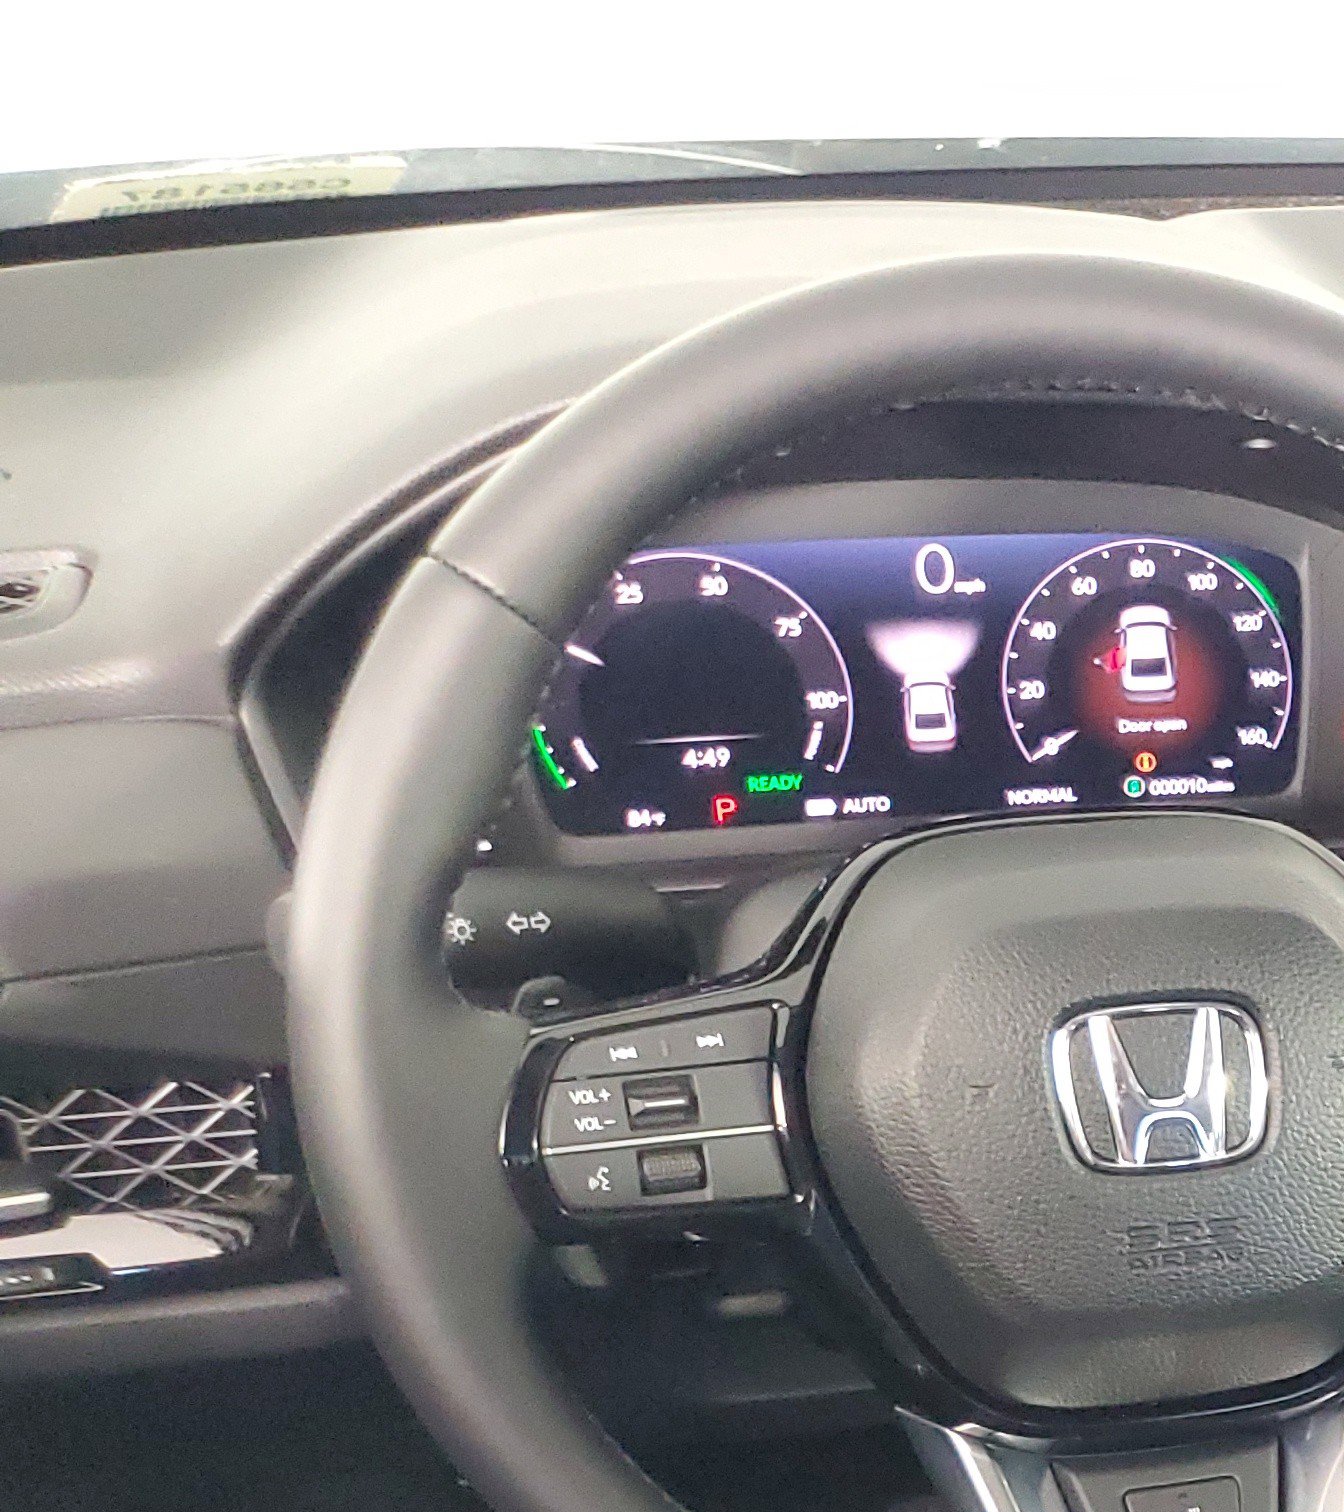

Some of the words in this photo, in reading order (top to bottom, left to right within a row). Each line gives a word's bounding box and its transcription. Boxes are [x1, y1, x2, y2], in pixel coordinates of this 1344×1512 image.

[915, 543, 955, 595] 0
[1130, 559, 1155, 578] 80
[616, 581, 643, 604] 25
[1071, 576, 1097, 596] 60
[1187, 573, 1218, 592] 100
[774, 617, 802, 637] 75
[1029, 621, 1056, 641] 40
[1233, 613, 1263, 632] 120
[1250, 670, 1281, 689] 140
[806, 690, 838, 710] 100
[1020, 681, 1045, 699] 20
[1118, 718, 1152, 734] Door
[1153, 718, 1188, 733] open
[1236, 727, 1268, 746] 160
[681, 746, 731, 769] 4:49
[747, 773, 803, 793] READY
[1149, 777, 1207, 796] 000010
[842, 796, 891, 814] AUTO
[1007, 786, 1078, 806] NORMAL
[713, 798, 737, 823] P
